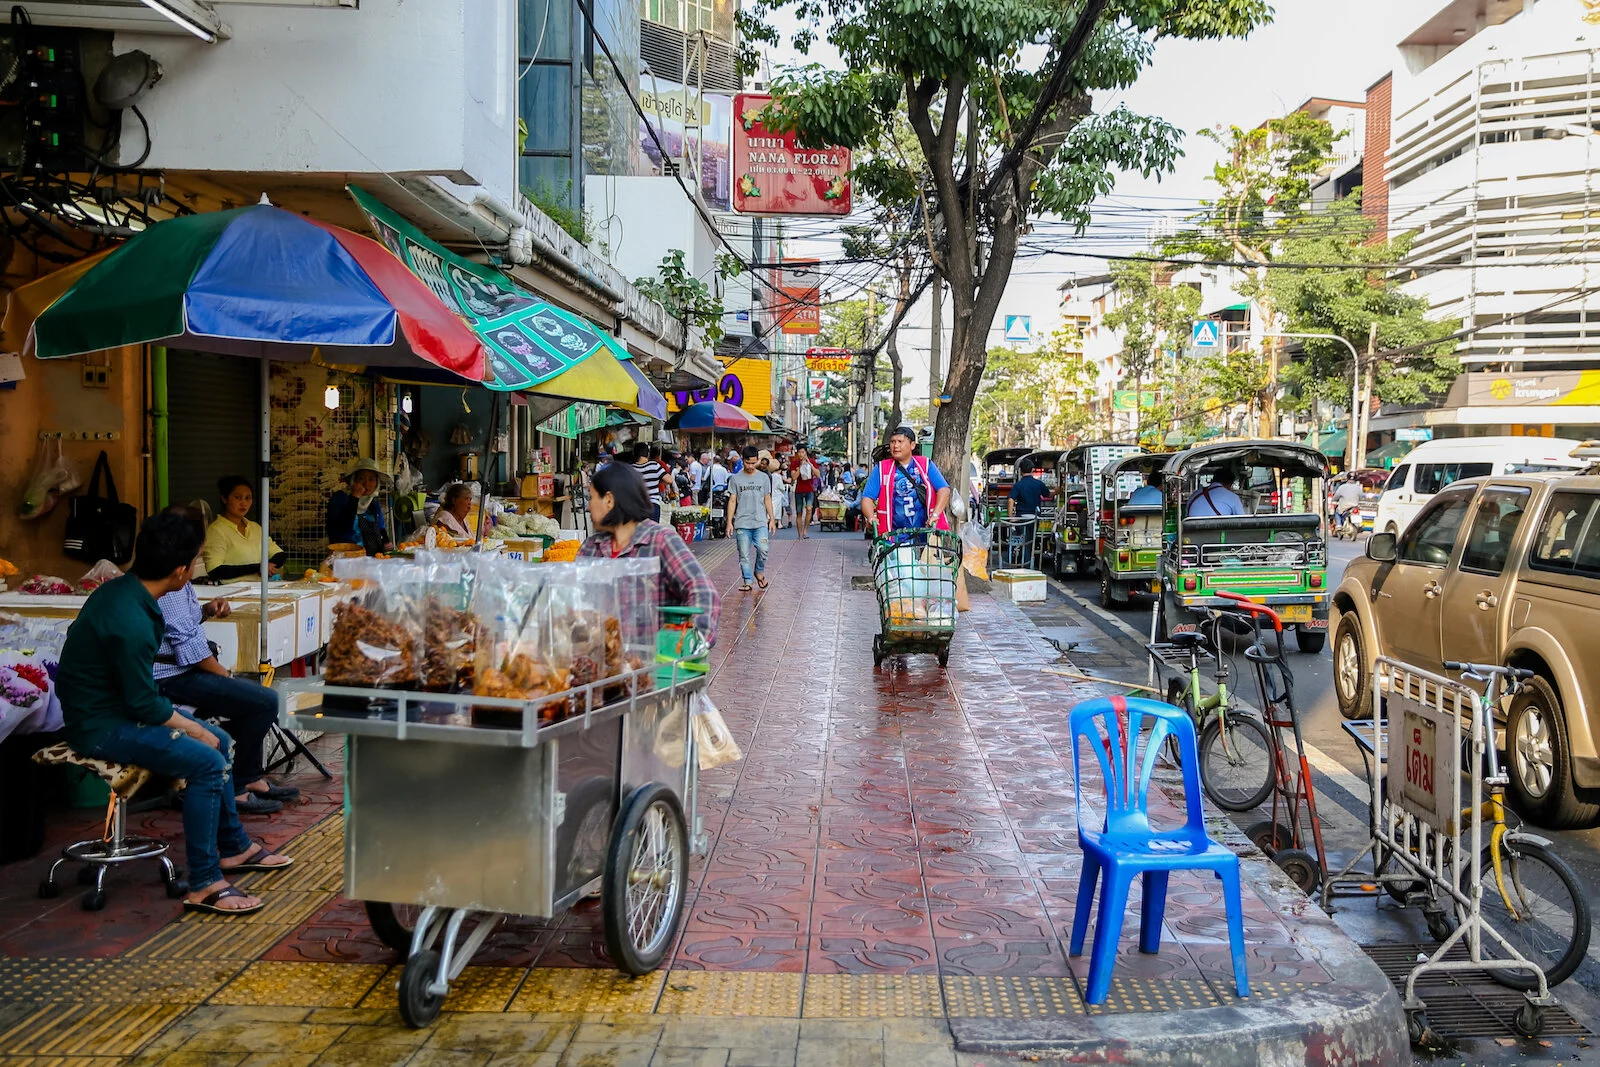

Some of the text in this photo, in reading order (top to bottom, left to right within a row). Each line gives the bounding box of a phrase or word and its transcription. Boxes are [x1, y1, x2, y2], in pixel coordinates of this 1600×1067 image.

[747, 137, 785, 149] นานา
[748, 152, 840, 165] NANA FLORA
[795, 310, 817, 320] ATM
[903, 496, 916, 518] 2
[1406, 727, 1434, 796] เต็ม
